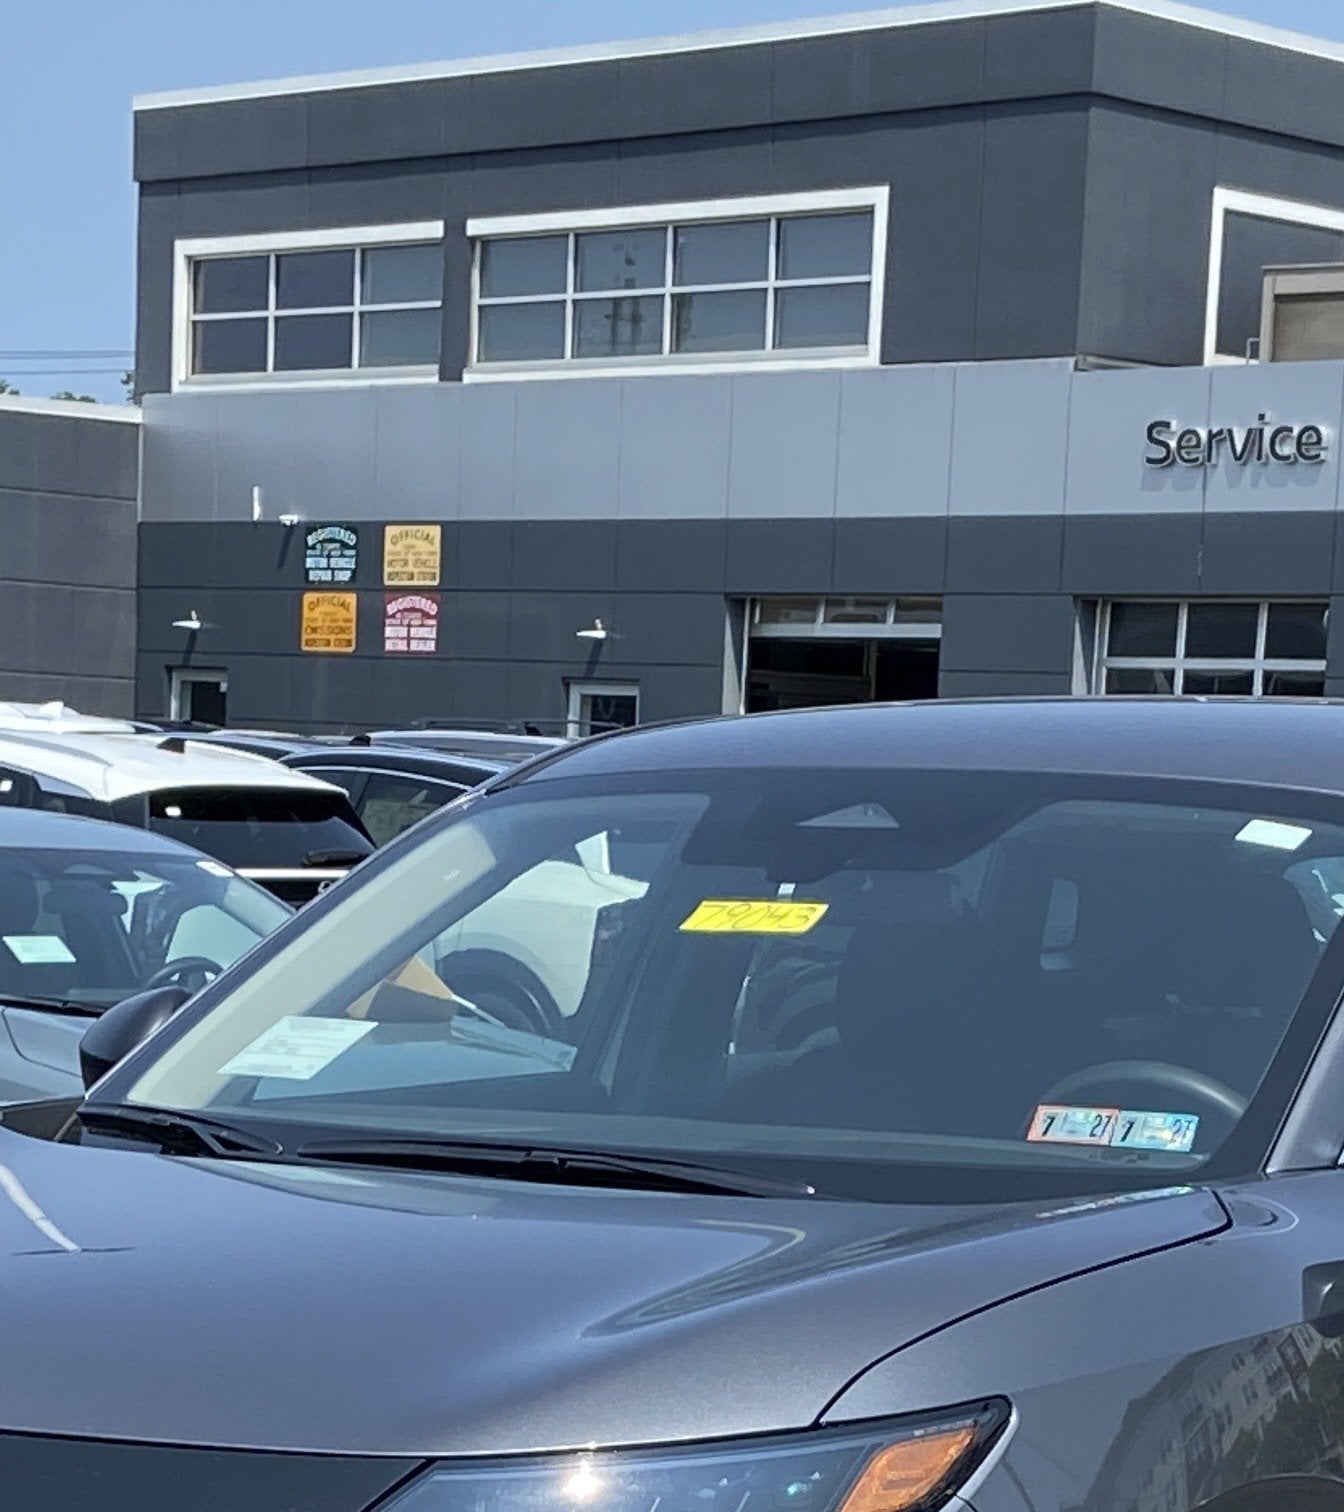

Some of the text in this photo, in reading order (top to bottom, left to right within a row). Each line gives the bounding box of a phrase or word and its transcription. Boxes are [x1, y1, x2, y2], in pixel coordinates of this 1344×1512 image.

[1145, 413, 1325, 465] Service
[390, 529, 436, 547] OFFICIAL
[308, 595, 352, 612] OFFICIAL
